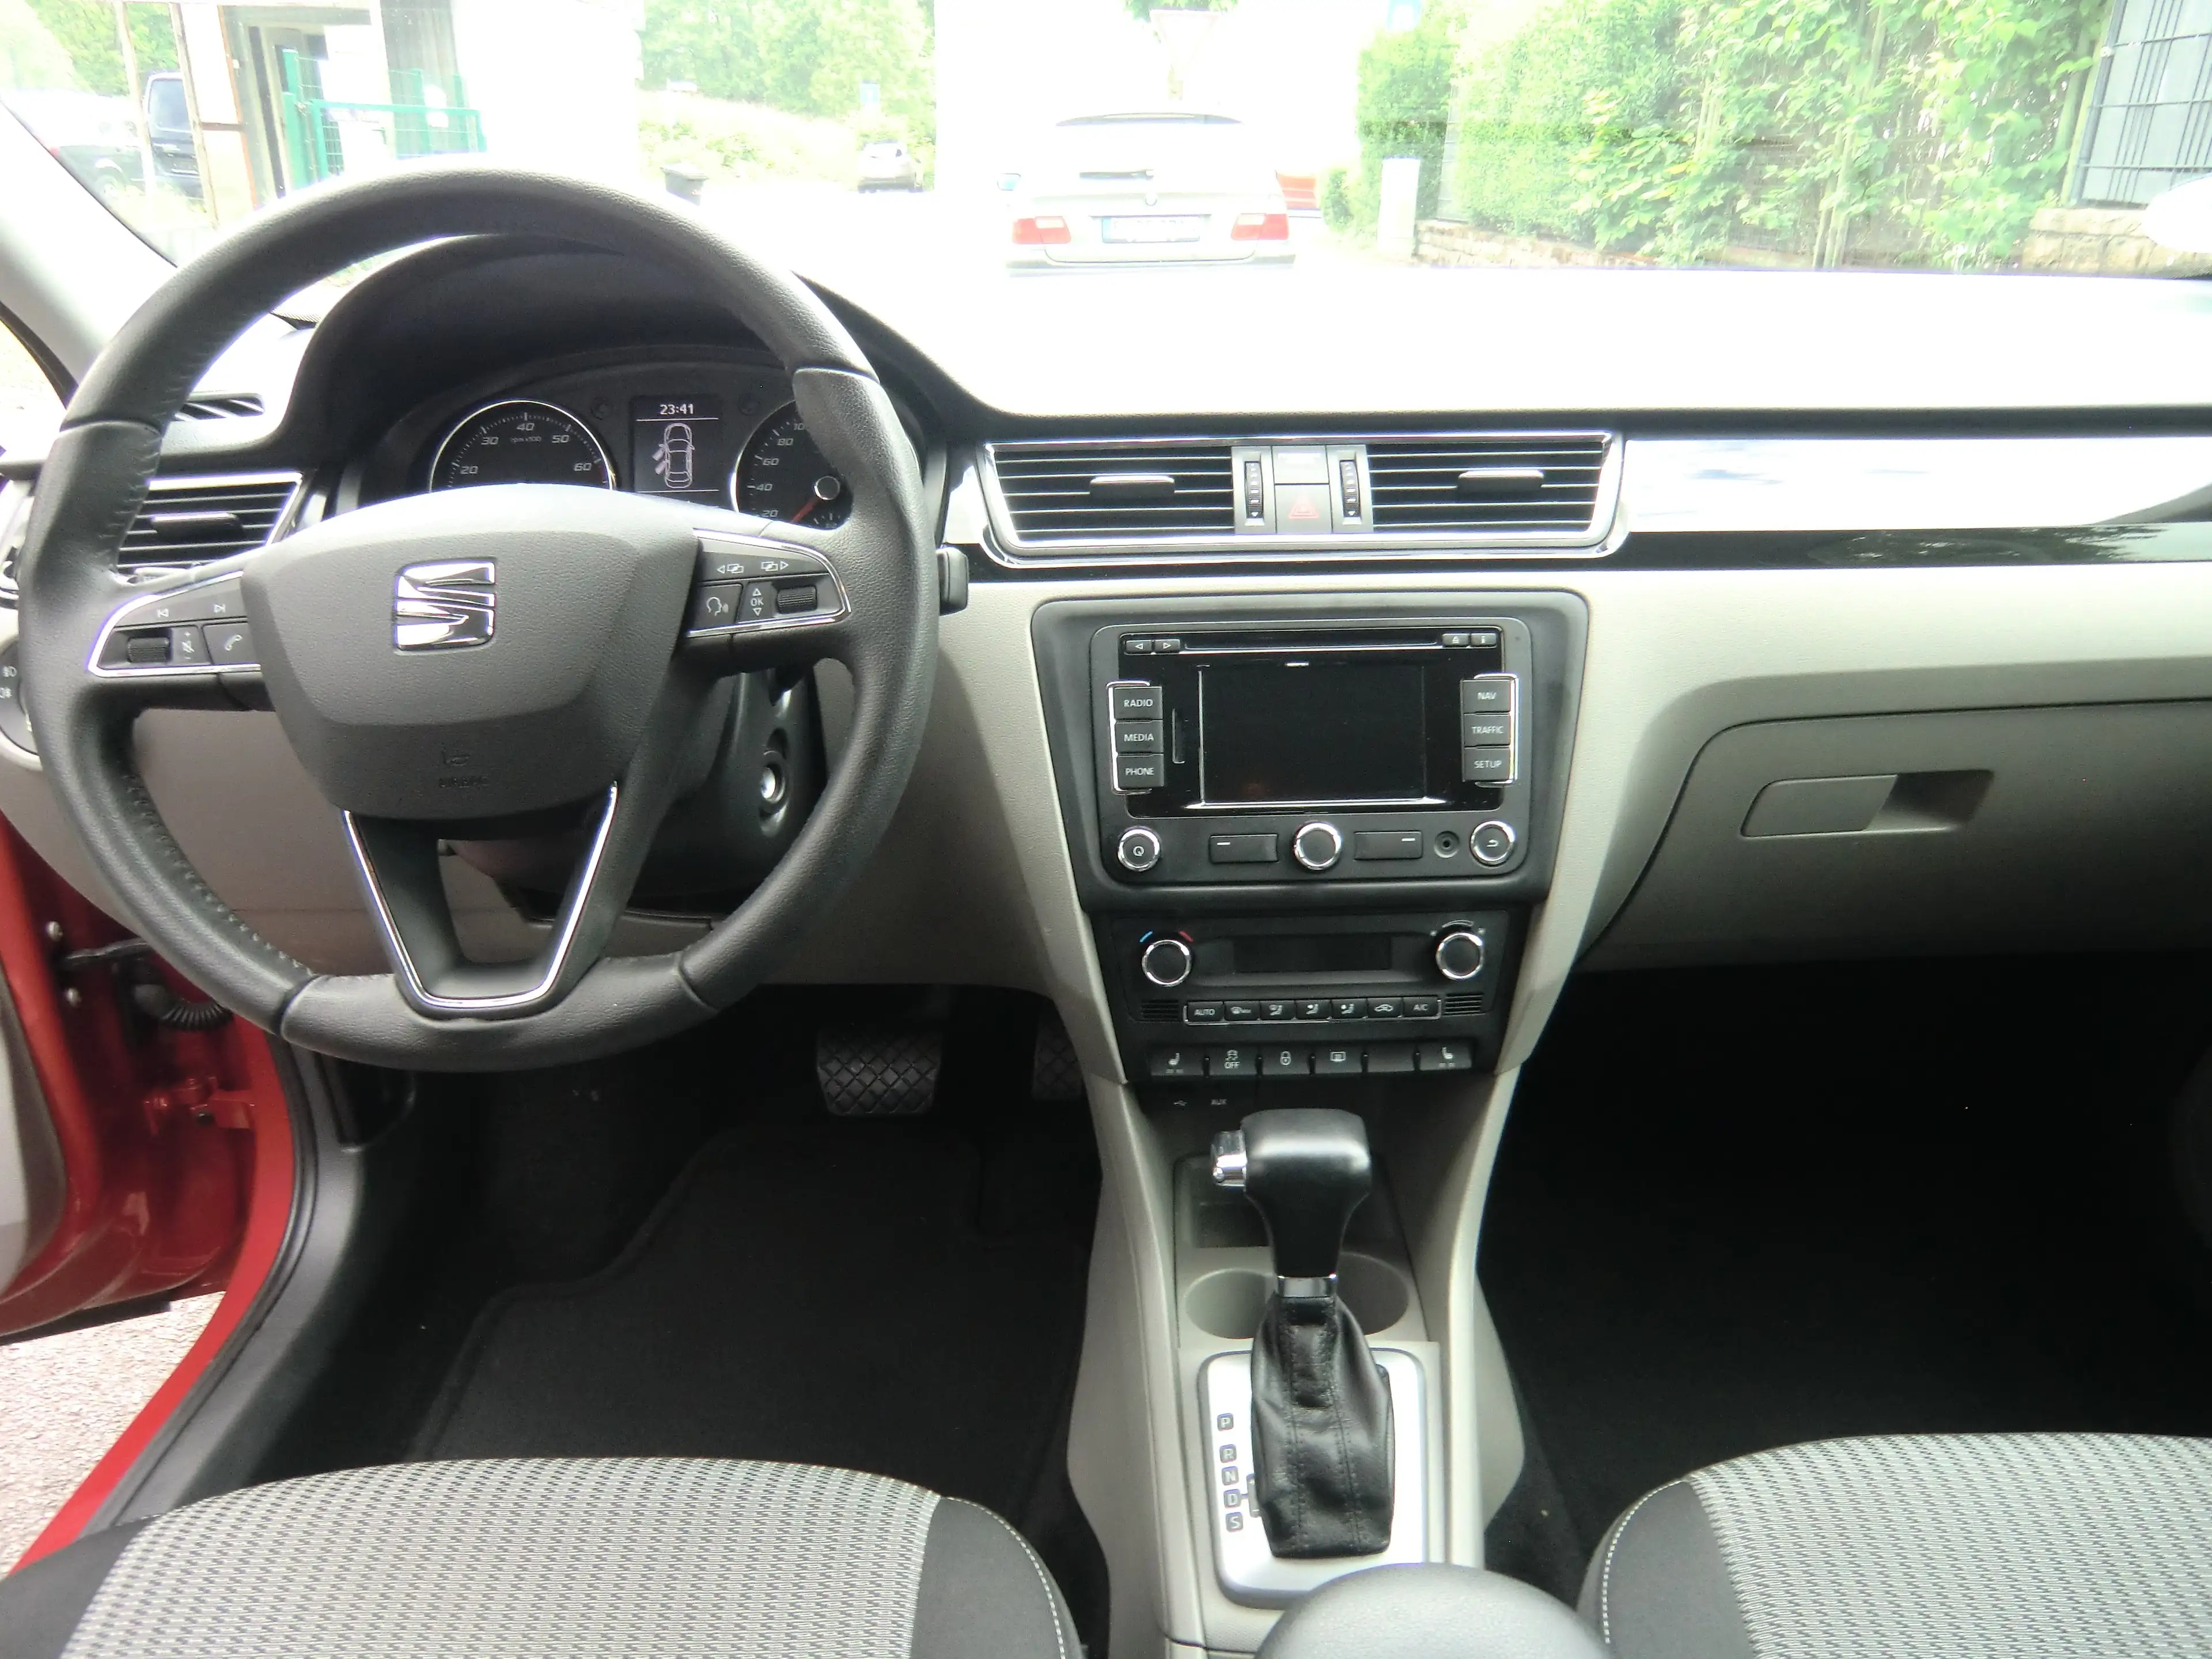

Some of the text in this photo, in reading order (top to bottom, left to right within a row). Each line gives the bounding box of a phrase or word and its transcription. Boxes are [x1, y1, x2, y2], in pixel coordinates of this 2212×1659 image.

[660, 403, 694, 415] 23:41
[516, 422, 535, 431] 40
[481, 436, 499, 445] 30
[551, 434, 570, 444] 50
[778, 438, 794, 446] 80
[460, 465, 479, 475] 20
[573, 463, 592, 471] 60
[756, 483, 773, 491] 40
[751, 597, 764, 606] OK
[1477, 692, 1497, 700] NAV
[1123, 699, 1153, 707] RADIO
[1471, 726, 1504, 734] TRAFFIC
[1123, 733, 1154, 742] MEDIA
[1474, 760, 1502, 769] SETUP
[1125, 767, 1154, 776] PHONE
[1194, 1008, 1215, 1016] AUTO
[1224, 1061, 1240, 1069] OFF
[1221, 1417, 1231, 1428] P
[1223, 1448, 1234, 1460] R
[1225, 1471, 1237, 1482] N
[1228, 1494, 1238, 1505] D
[1230, 1516, 1241, 1529] S
